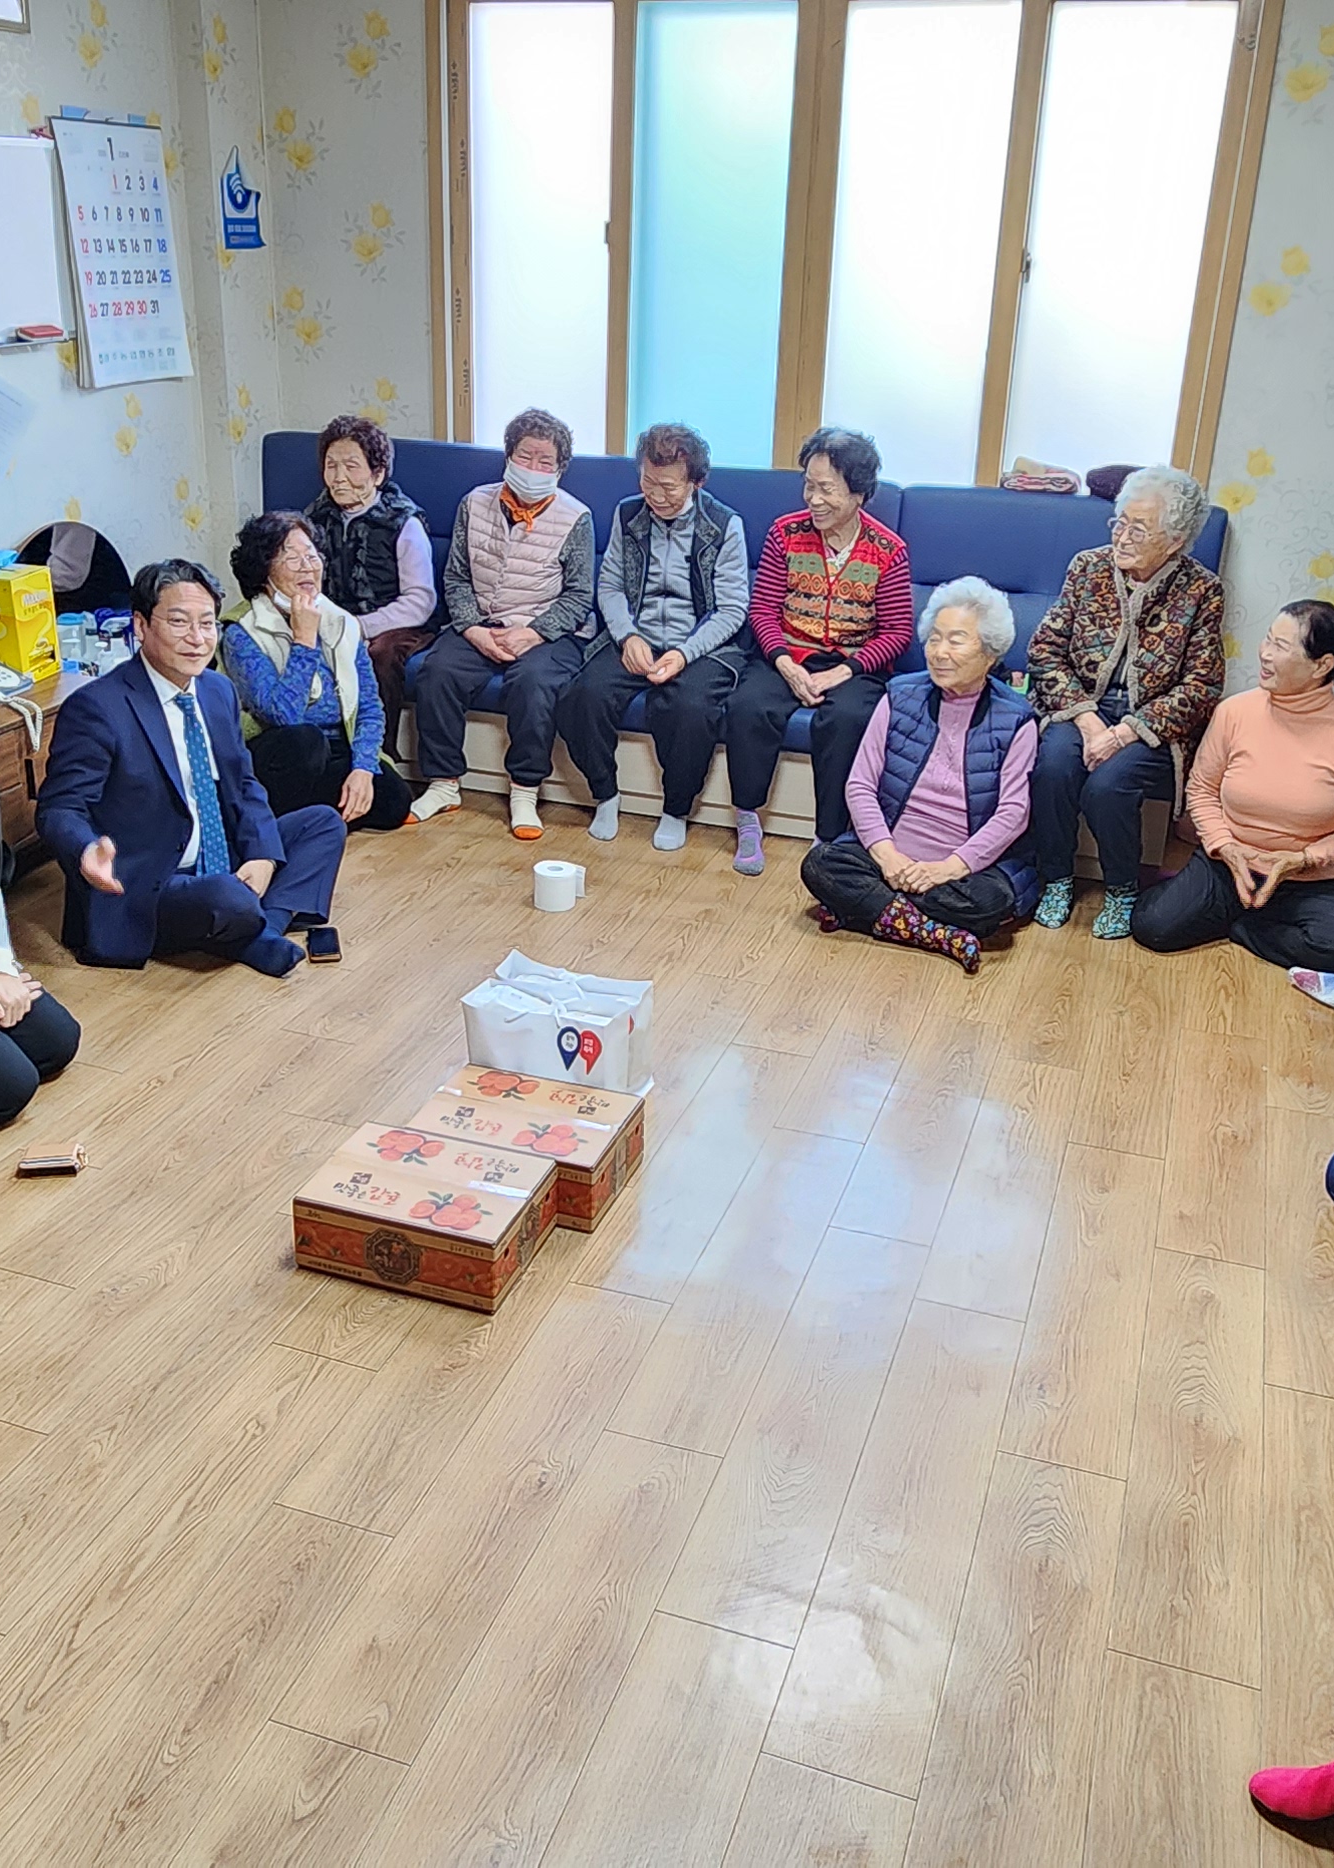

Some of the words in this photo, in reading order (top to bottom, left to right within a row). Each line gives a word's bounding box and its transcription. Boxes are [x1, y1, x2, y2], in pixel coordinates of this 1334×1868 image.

[107, 137, 114, 161] 1
[113, 174, 118, 190] 1
[125, 175, 132, 191] 2
[139, 176, 145, 191] 3
[152, 177, 159, 191] 4
[77, 205, 84, 221] 5
[92, 205, 98, 221] 6
[104, 206, 109, 221] 7
[116, 206, 123, 222] 8
[128, 207, 134, 222] 9
[140, 207, 150, 223] 10
[154, 208, 163, 223] 11
[80, 238, 89, 254] 12
[93, 238, 102, 254] 13
[106, 238, 115, 254] 14
[118, 238, 127, 254] 15
[130, 238, 140, 254] 16
[143, 238, 152, 254] 17
[157, 238, 167, 254] 18
[85, 271, 93, 286] 19
[96, 270, 106, 286] 20
[110, 270, 118, 285] 21
[121, 269, 131, 285] 22
[133, 269, 144, 285] 23
[146, 269, 158, 284] 24
[160, 269, 172, 283] 25
[89, 303, 98, 319] 26
[100, 302, 109, 317] 27
[112, 301, 123, 317] 28
[124, 301, 135, 316] 29
[137, 300, 147, 315] 30
[150, 299, 160, 315] 31
